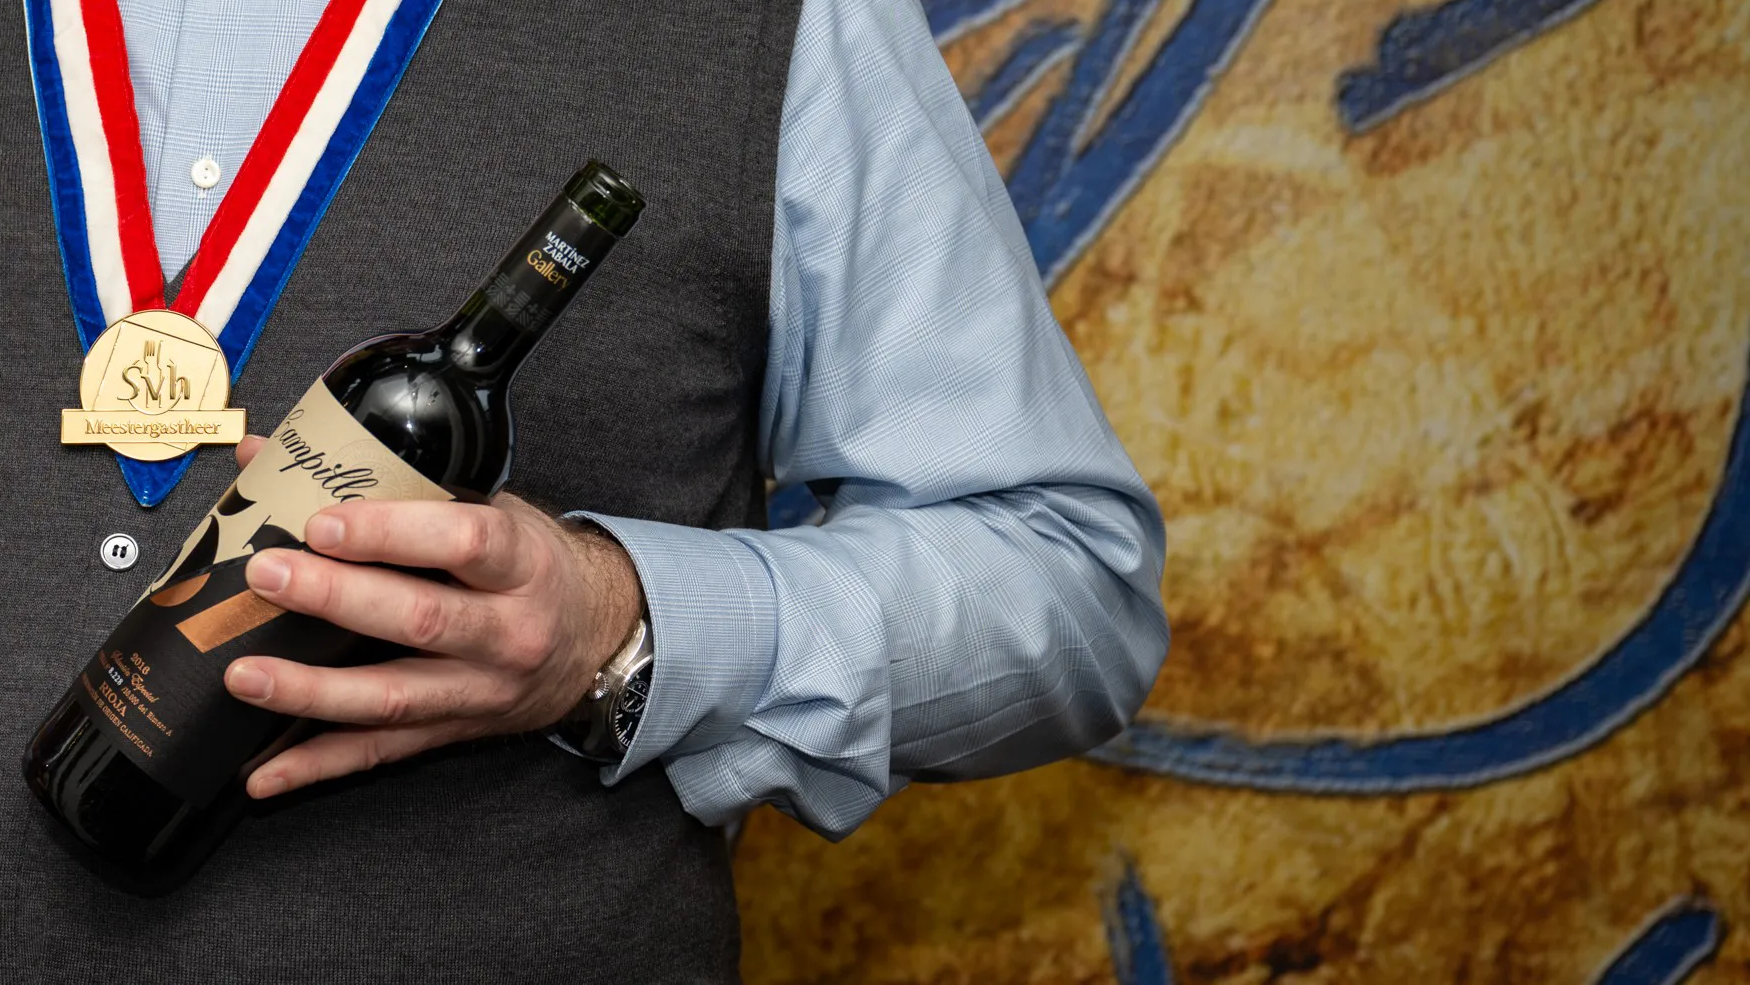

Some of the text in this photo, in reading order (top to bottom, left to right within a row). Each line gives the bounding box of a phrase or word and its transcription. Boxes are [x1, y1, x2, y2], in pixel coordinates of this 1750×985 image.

[543, 242, 578, 274] ZABALA
[545, 230, 590, 268] MARTÍNEZ
[527, 249, 569, 292] Gallery
[84, 417, 222, 438] Meestergastheer
[98, 680, 128, 718] RIOJA
[102, 705, 123, 727] ORIGEN
[119, 724, 154, 758] CALIFICADA
